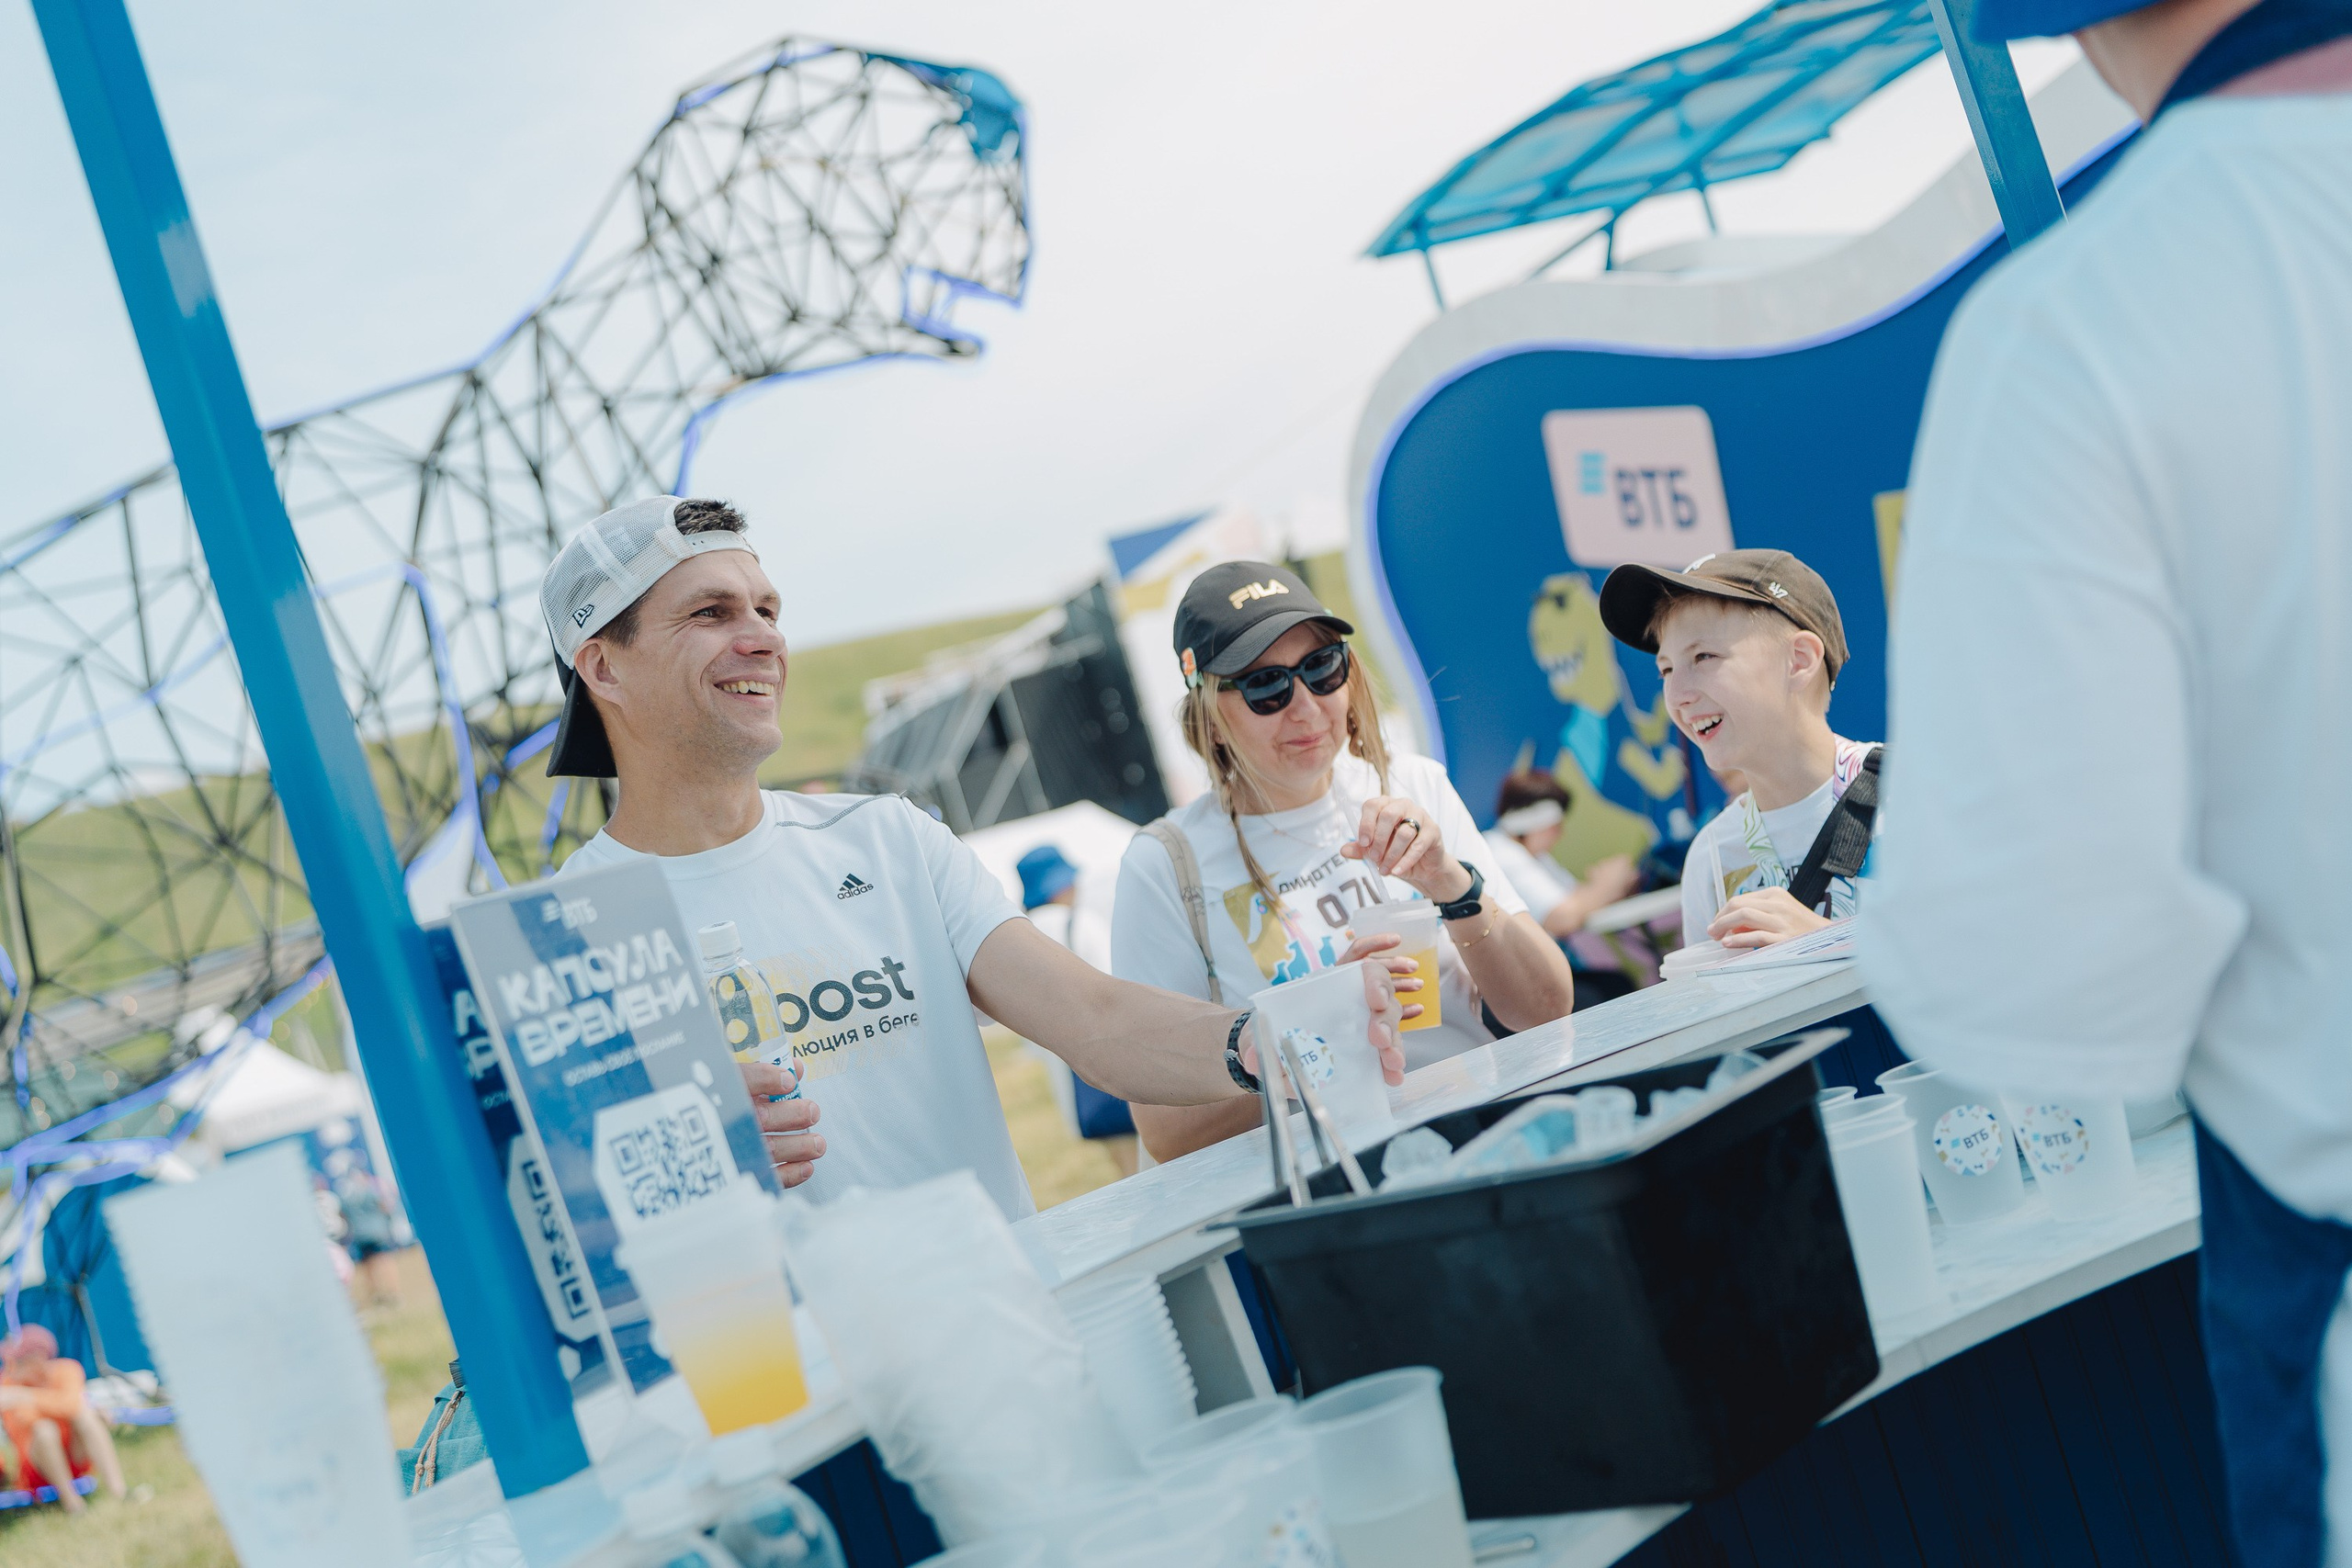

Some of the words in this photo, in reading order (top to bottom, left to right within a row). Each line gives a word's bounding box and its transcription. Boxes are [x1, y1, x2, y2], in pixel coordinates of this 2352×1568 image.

[1614, 467, 1699, 530] ВТБ
[1228, 579, 1290, 610] FILA
[1768, 581, 1789, 599] 47
[837, 884, 874, 900] adidas
[497, 928, 684, 1021] КАПСУЛА
[514, 971, 701, 1068] ВРЕМЕНИ
[793, 1029, 859, 1057] люция
[864, 1024, 876, 1039] в
[1299, 1050, 1318, 1067] ТБ
[1963, 1128, 1990, 1149] ВТБ
[2043, 1132, 2072, 1148] ВТБ
